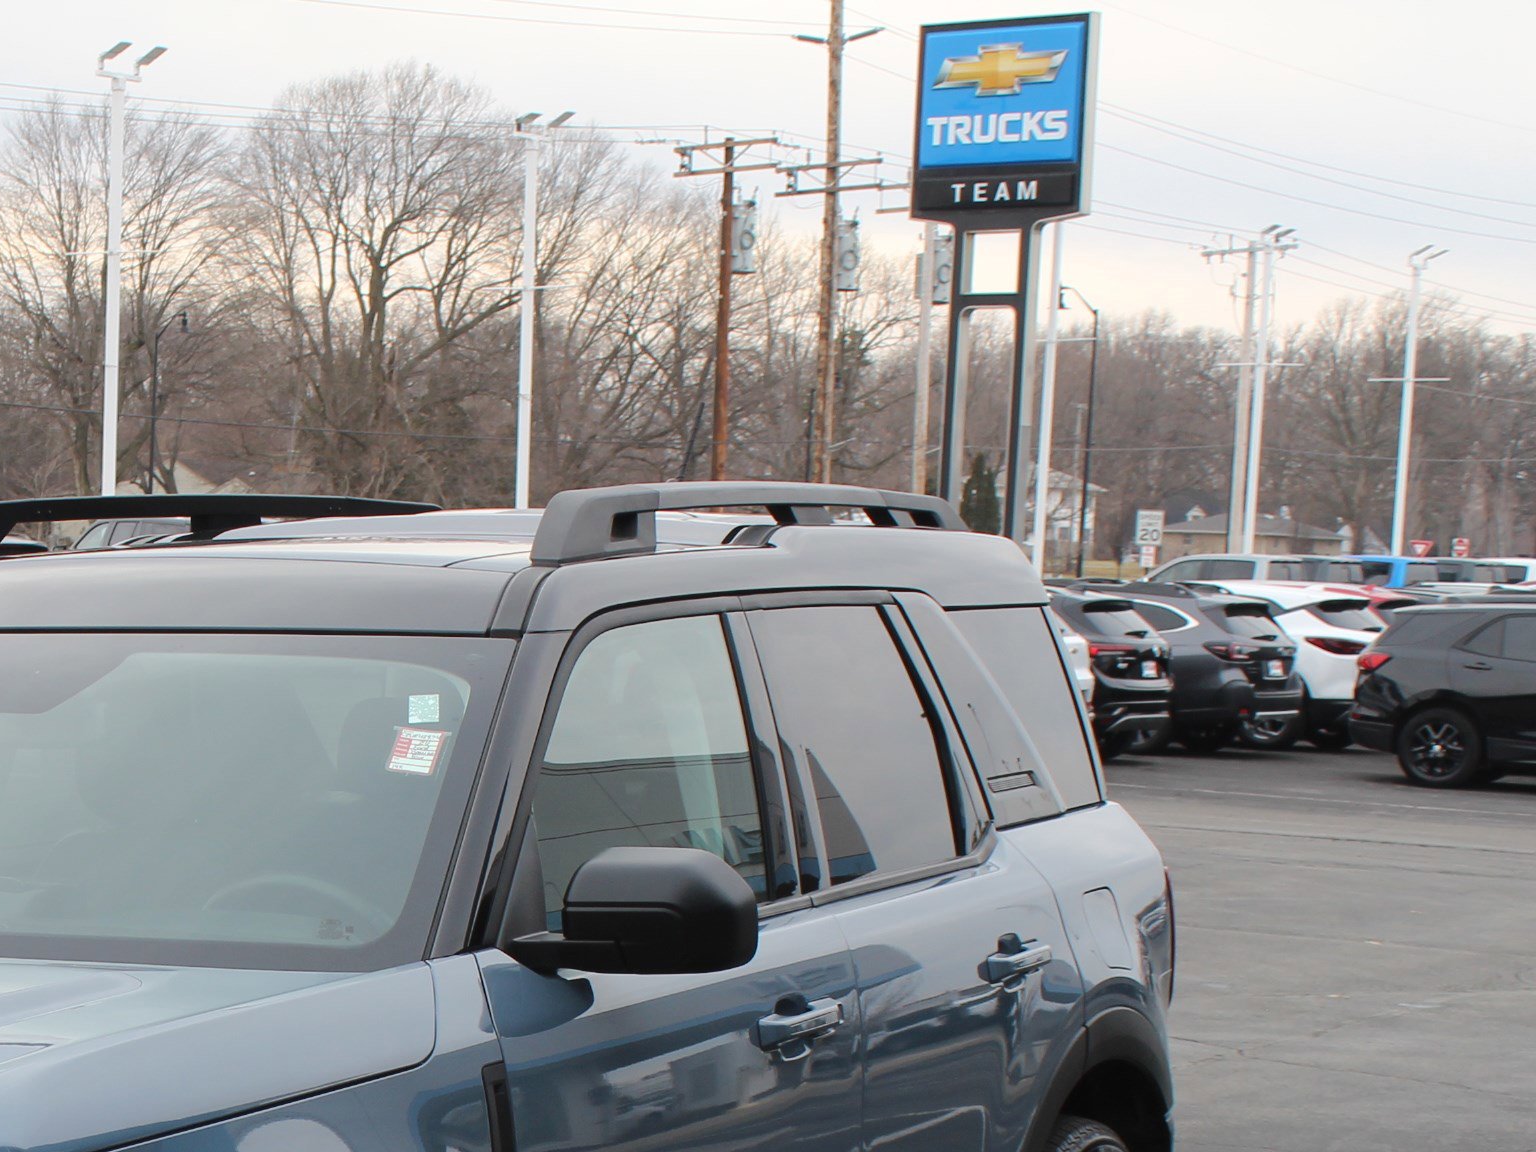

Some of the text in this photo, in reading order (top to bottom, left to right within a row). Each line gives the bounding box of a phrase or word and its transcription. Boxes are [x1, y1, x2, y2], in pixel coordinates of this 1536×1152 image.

[927, 110, 1069, 146] TRUCKS
[951, 180, 1038, 203] TEAM
[1139, 528, 1161, 542] 20
